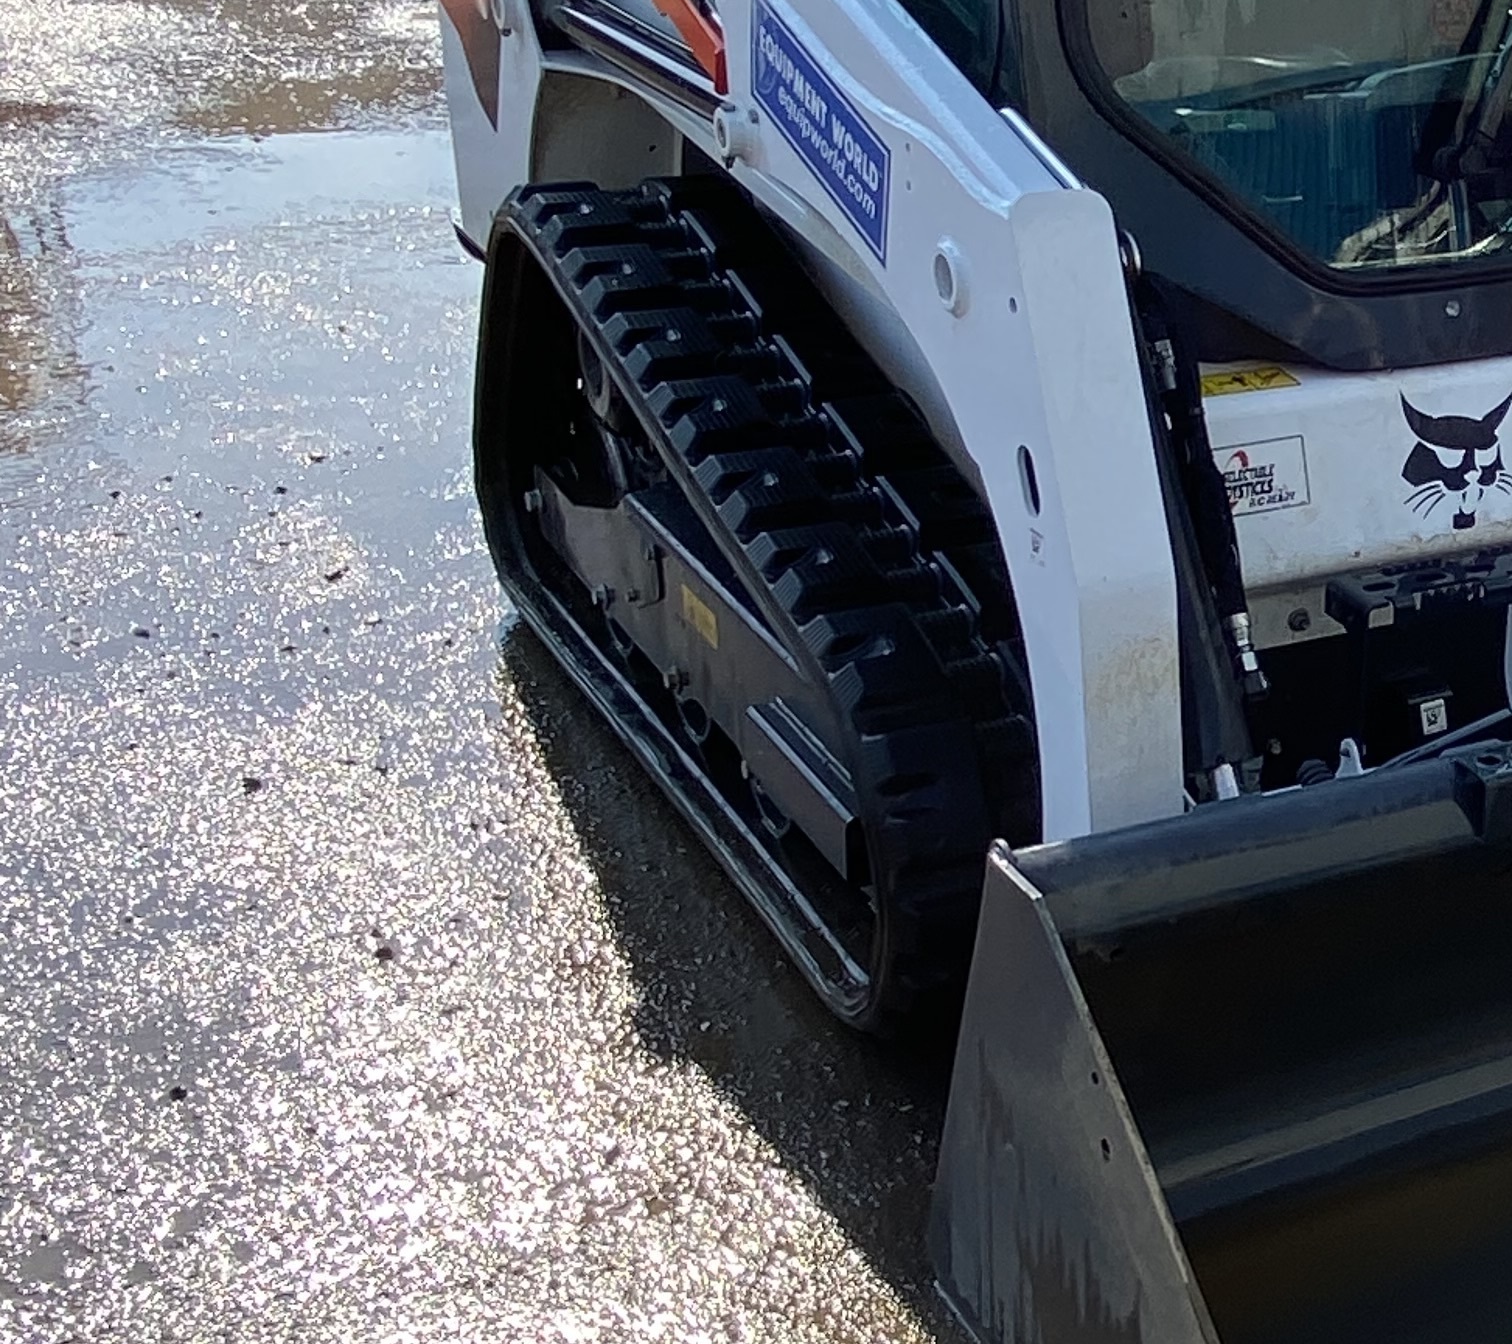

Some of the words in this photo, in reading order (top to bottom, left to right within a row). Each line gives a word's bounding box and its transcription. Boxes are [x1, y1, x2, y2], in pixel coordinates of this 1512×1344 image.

[758, 24, 828, 130] EQUIPMENT
[831, 112, 881, 194] WORLD
[777, 84, 877, 221] equipworld.com
